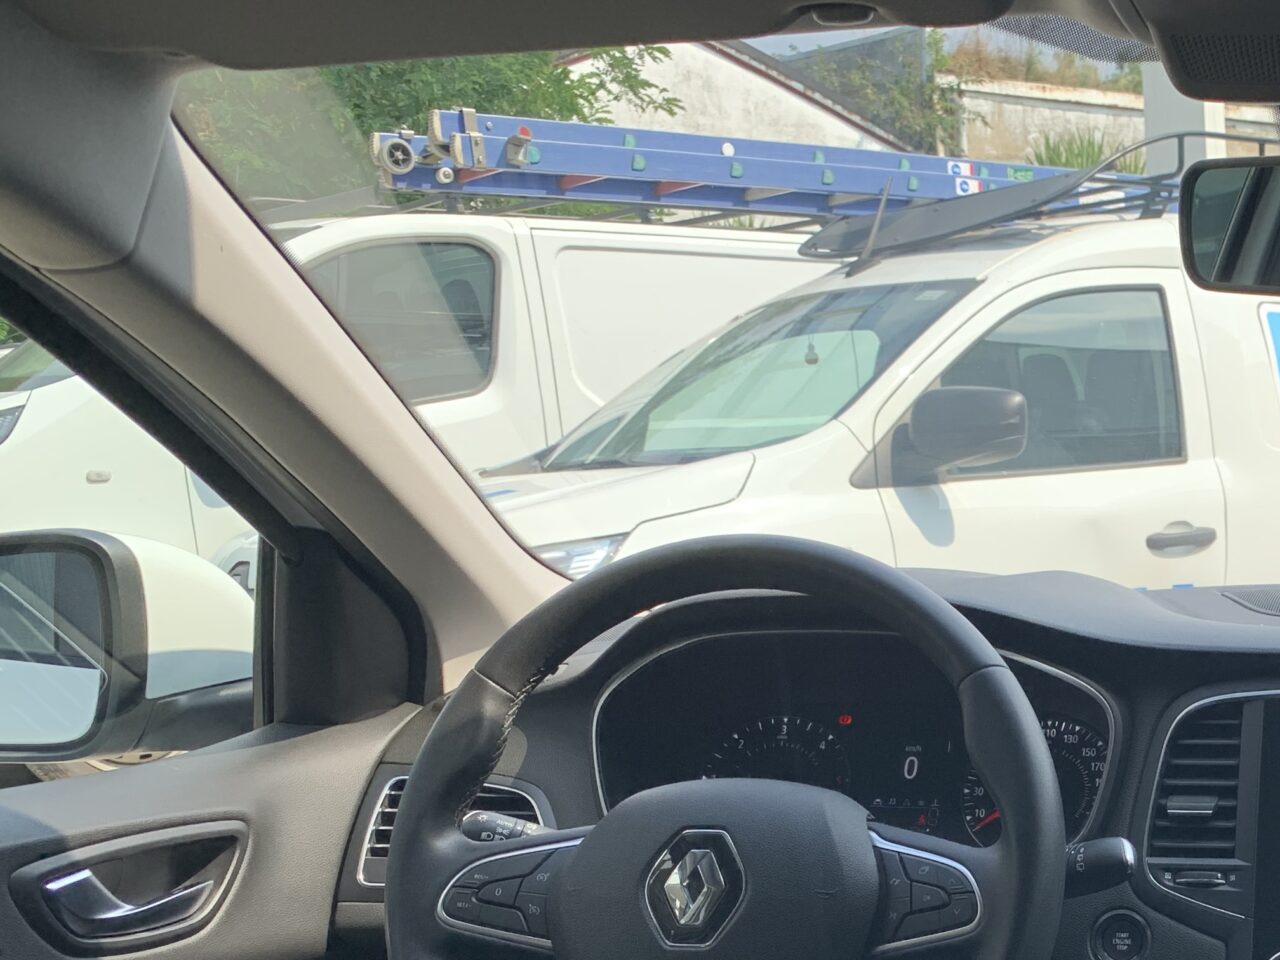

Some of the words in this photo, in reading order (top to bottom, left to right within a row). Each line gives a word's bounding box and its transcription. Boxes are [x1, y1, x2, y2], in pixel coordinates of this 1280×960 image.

[782, 725, 788, 734] 3
[1046, 728, 1057, 738] 10
[1063, 734, 1079, 744] 130
[737, 740, 745, 749] 2
[819, 741, 826, 750] 4
[1081, 747, 1097, 757] 150
[903, 756, 918, 779] 0
[972, 787, 984, 796] 30
[975, 808, 986, 818] 10
